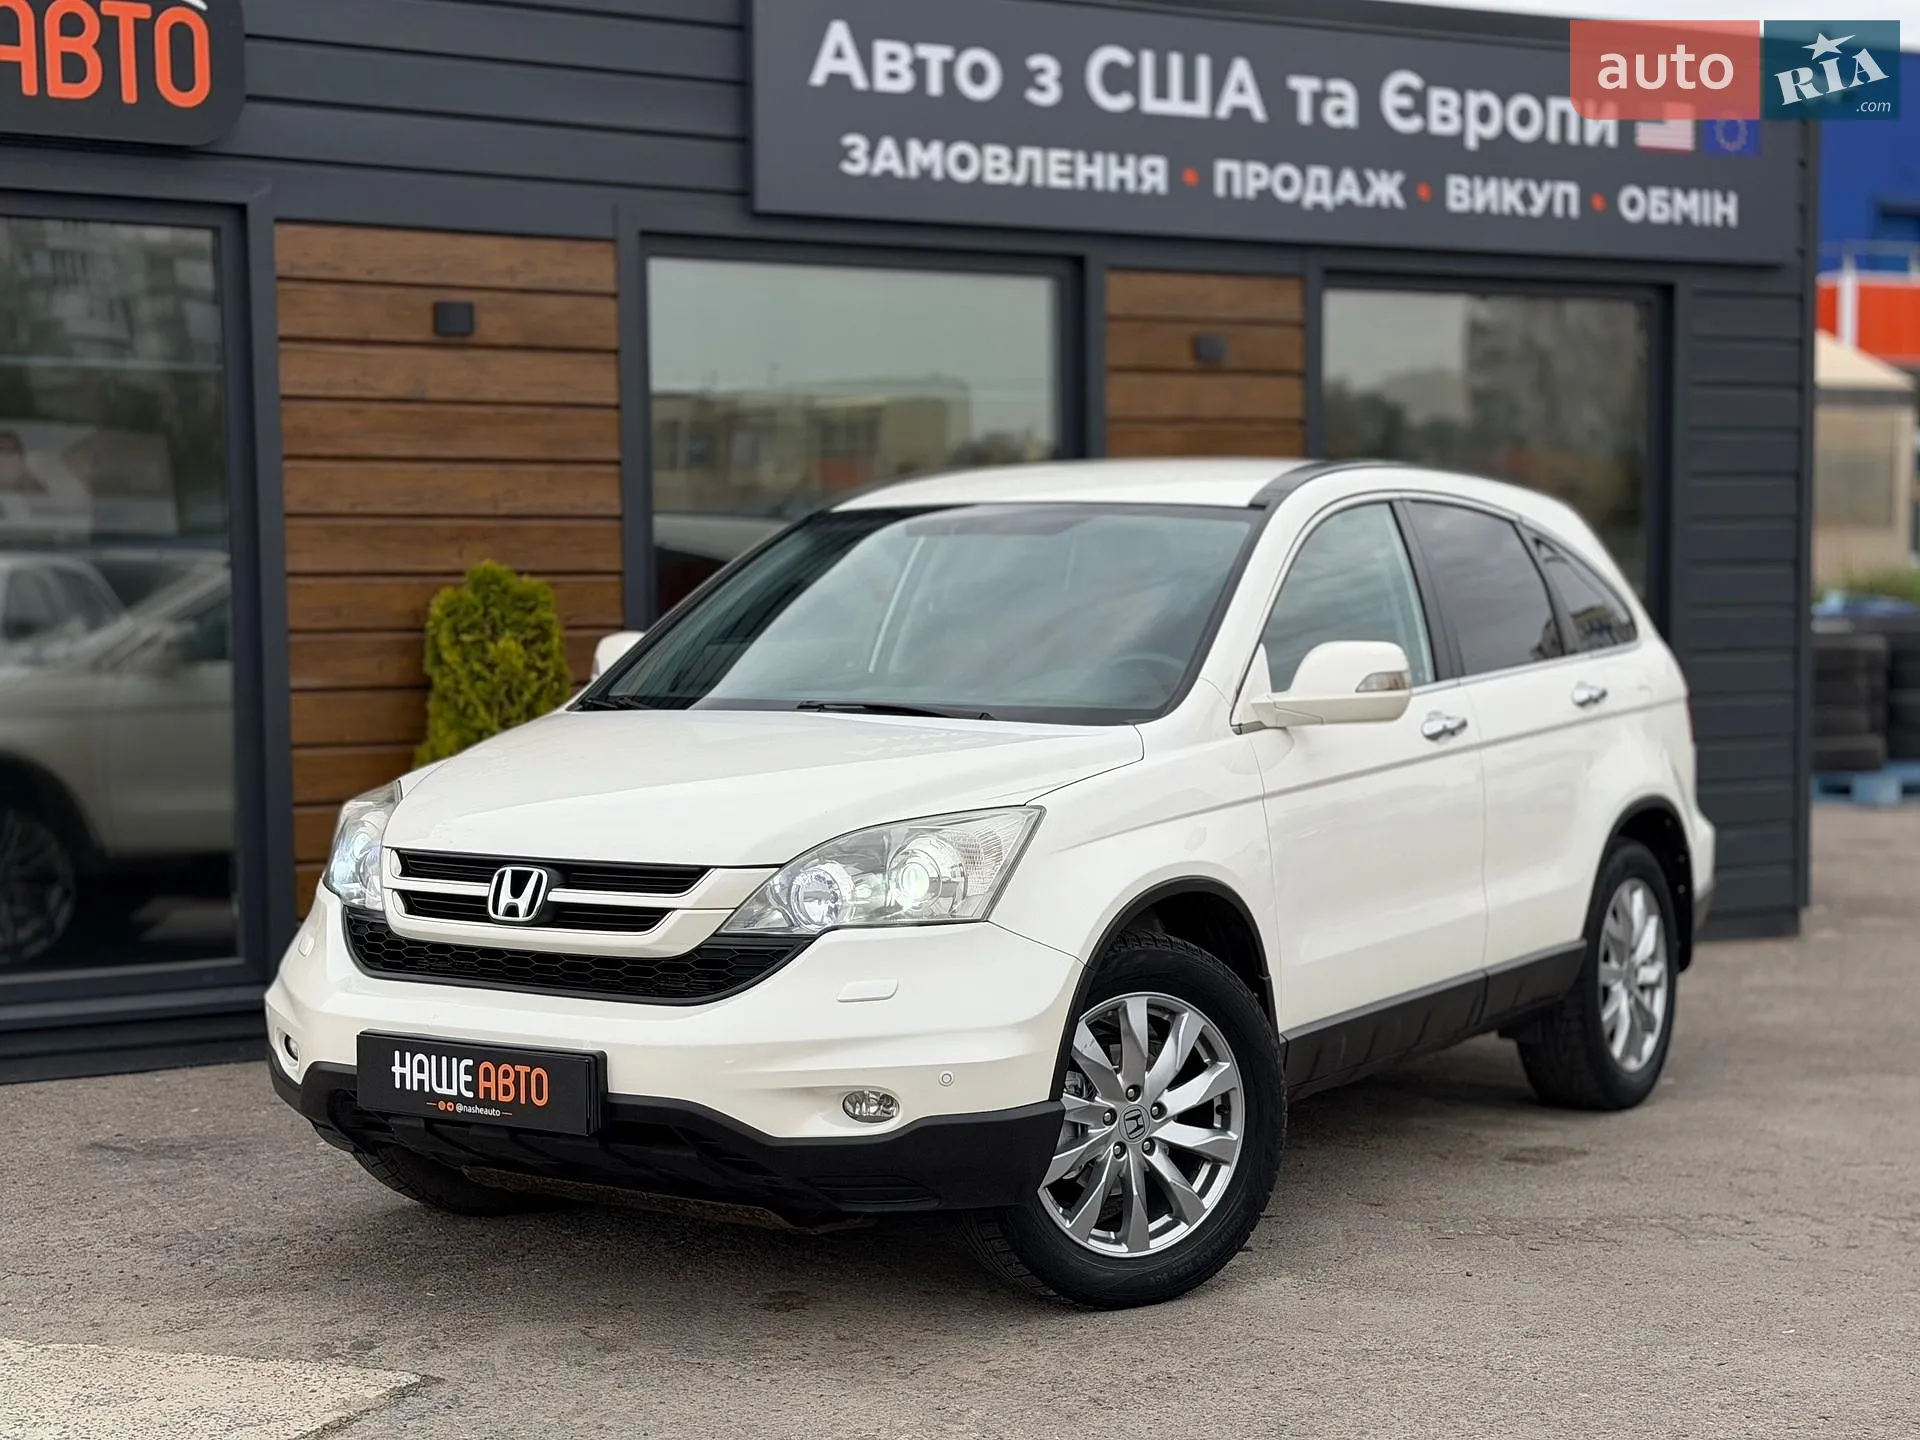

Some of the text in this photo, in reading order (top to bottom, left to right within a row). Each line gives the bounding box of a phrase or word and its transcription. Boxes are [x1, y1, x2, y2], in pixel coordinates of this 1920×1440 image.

[808, 19, 1619, 150] Авто з США та Європи
[839, 134, 1738, 228] ЗАМОВЛЕННЯ ПРОДАЖ ВИКУП ОБМІН
[391, 1050, 549, 1107] НАШЕ АВТО
[455, 1102, 501, 1117] @nasheauto
